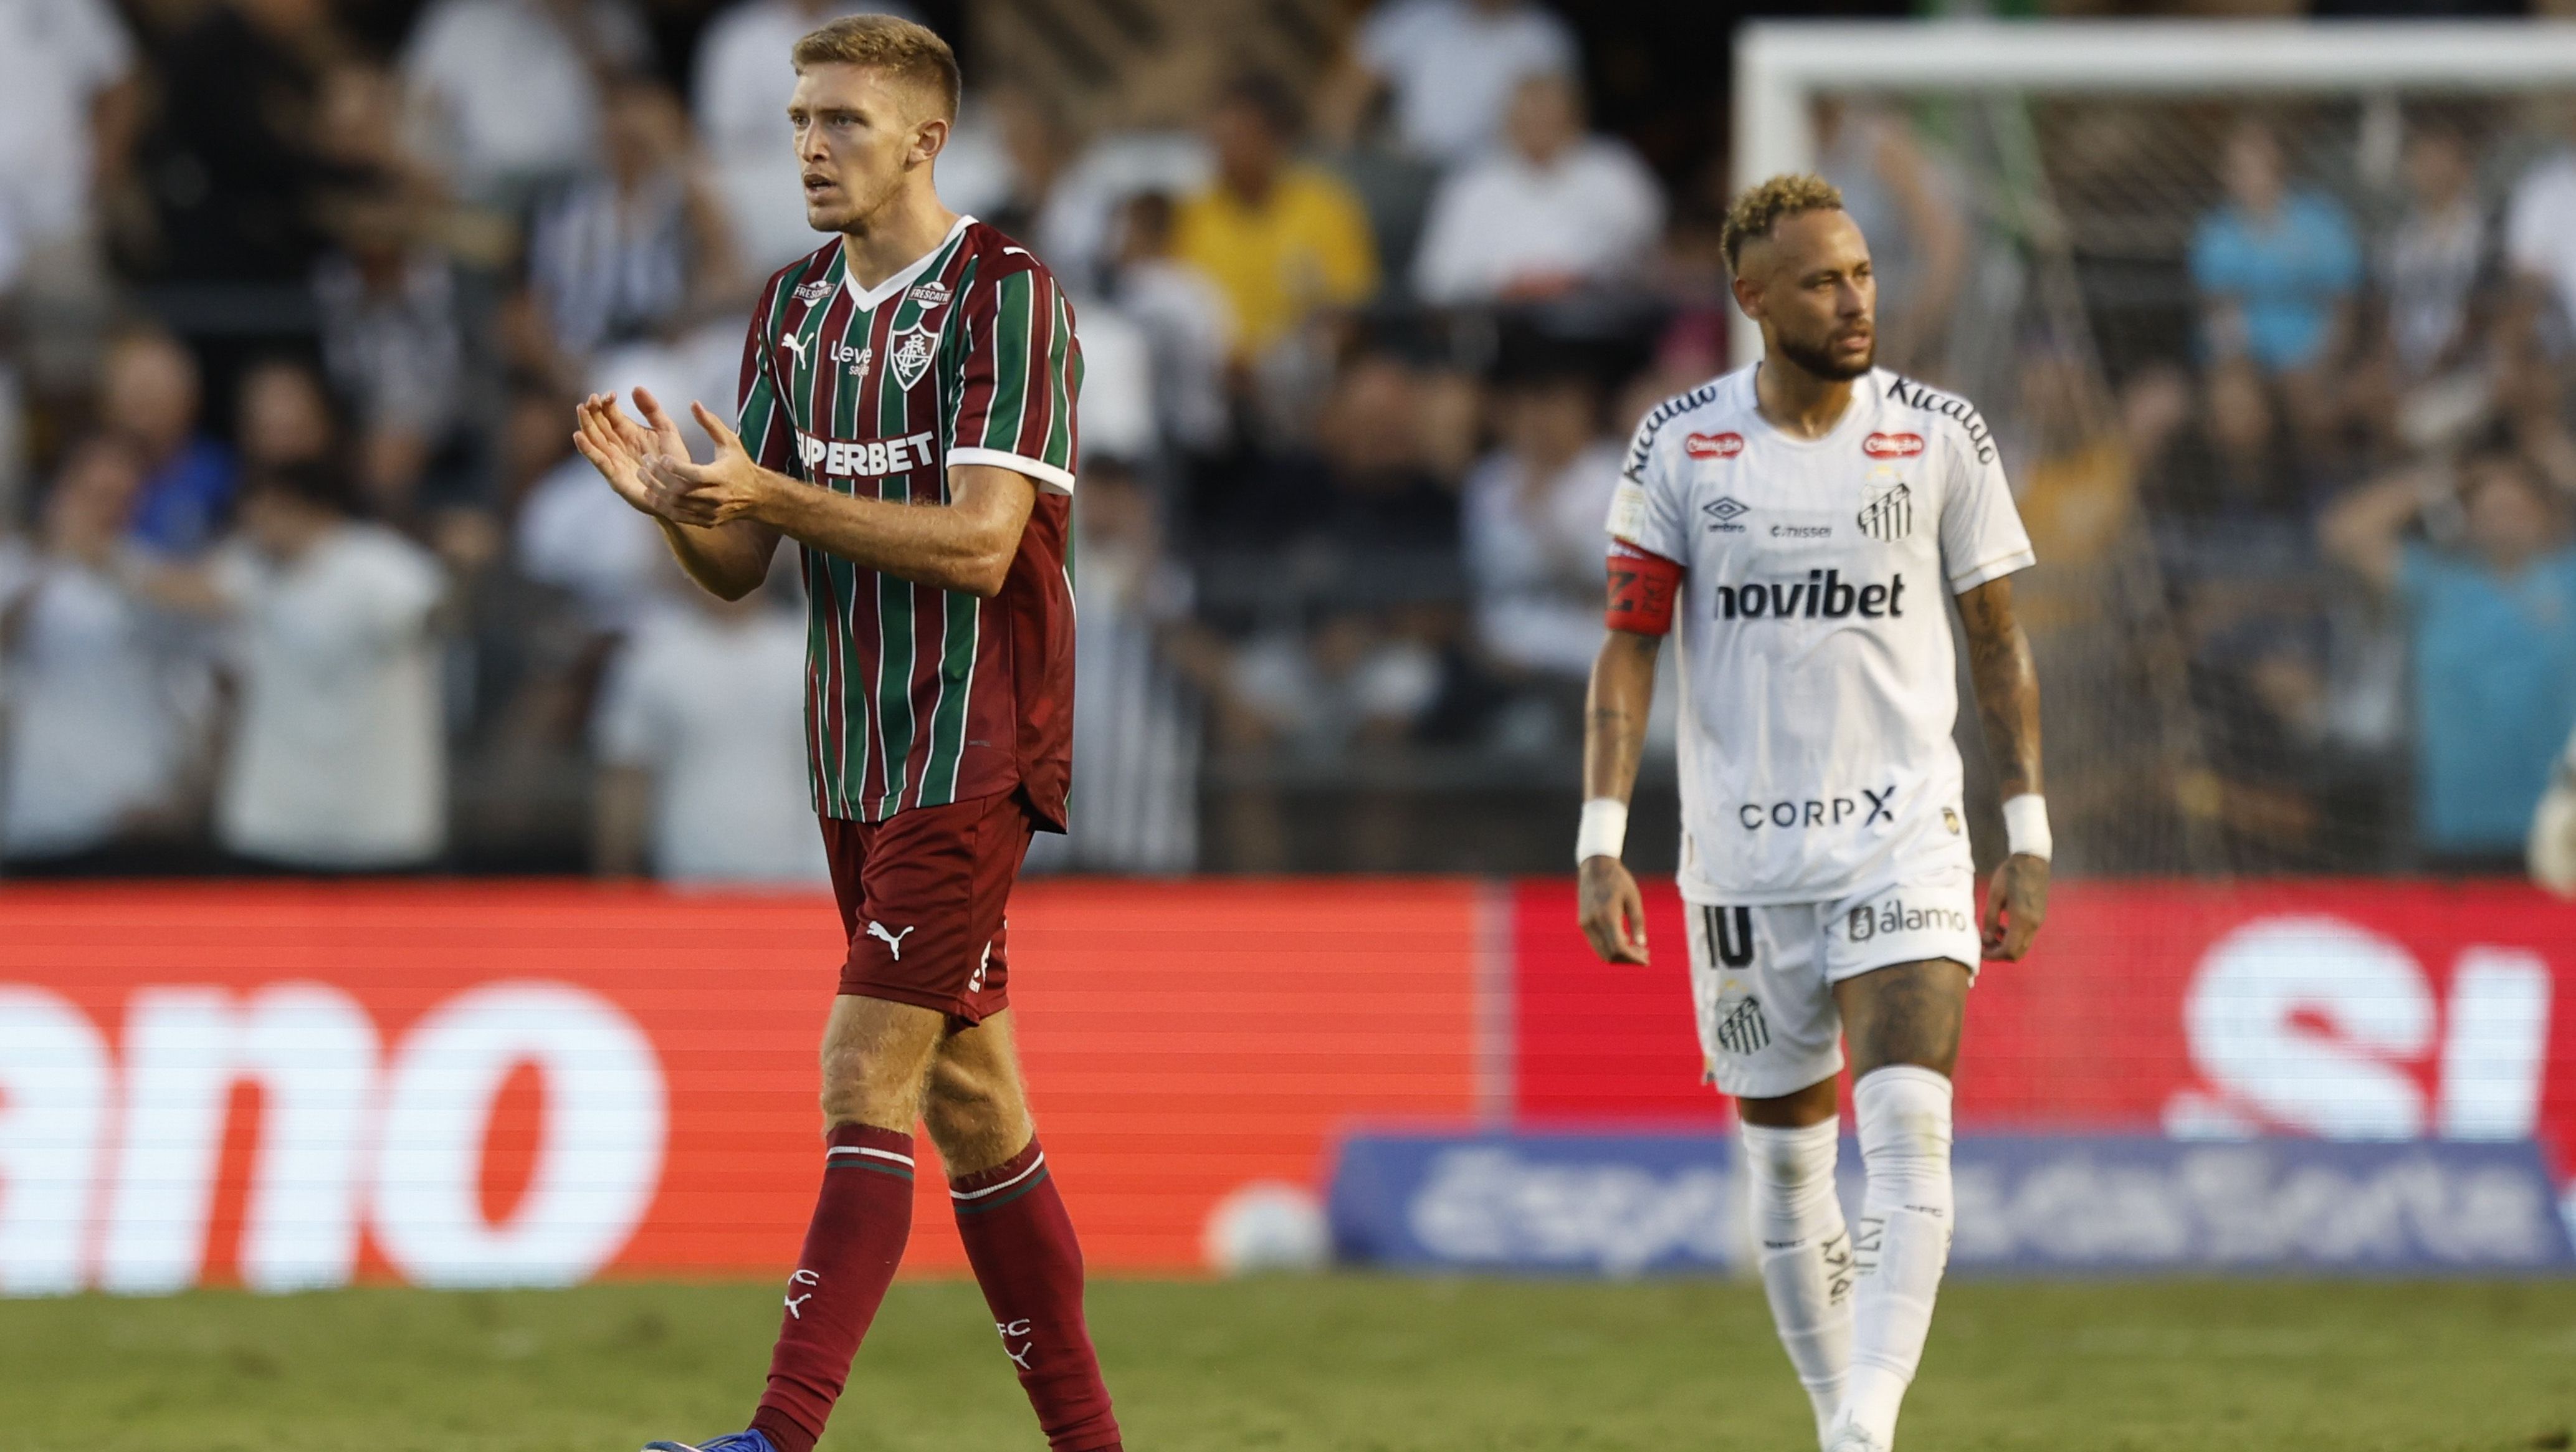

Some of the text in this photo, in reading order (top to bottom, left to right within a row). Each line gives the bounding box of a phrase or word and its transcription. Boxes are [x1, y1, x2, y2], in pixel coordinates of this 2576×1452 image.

[830, 340, 872, 365] Leve
[1717, 569, 1905, 618] novibet
[1704, 905, 1754, 969] 10
[1880, 899, 1968, 934] álamo
